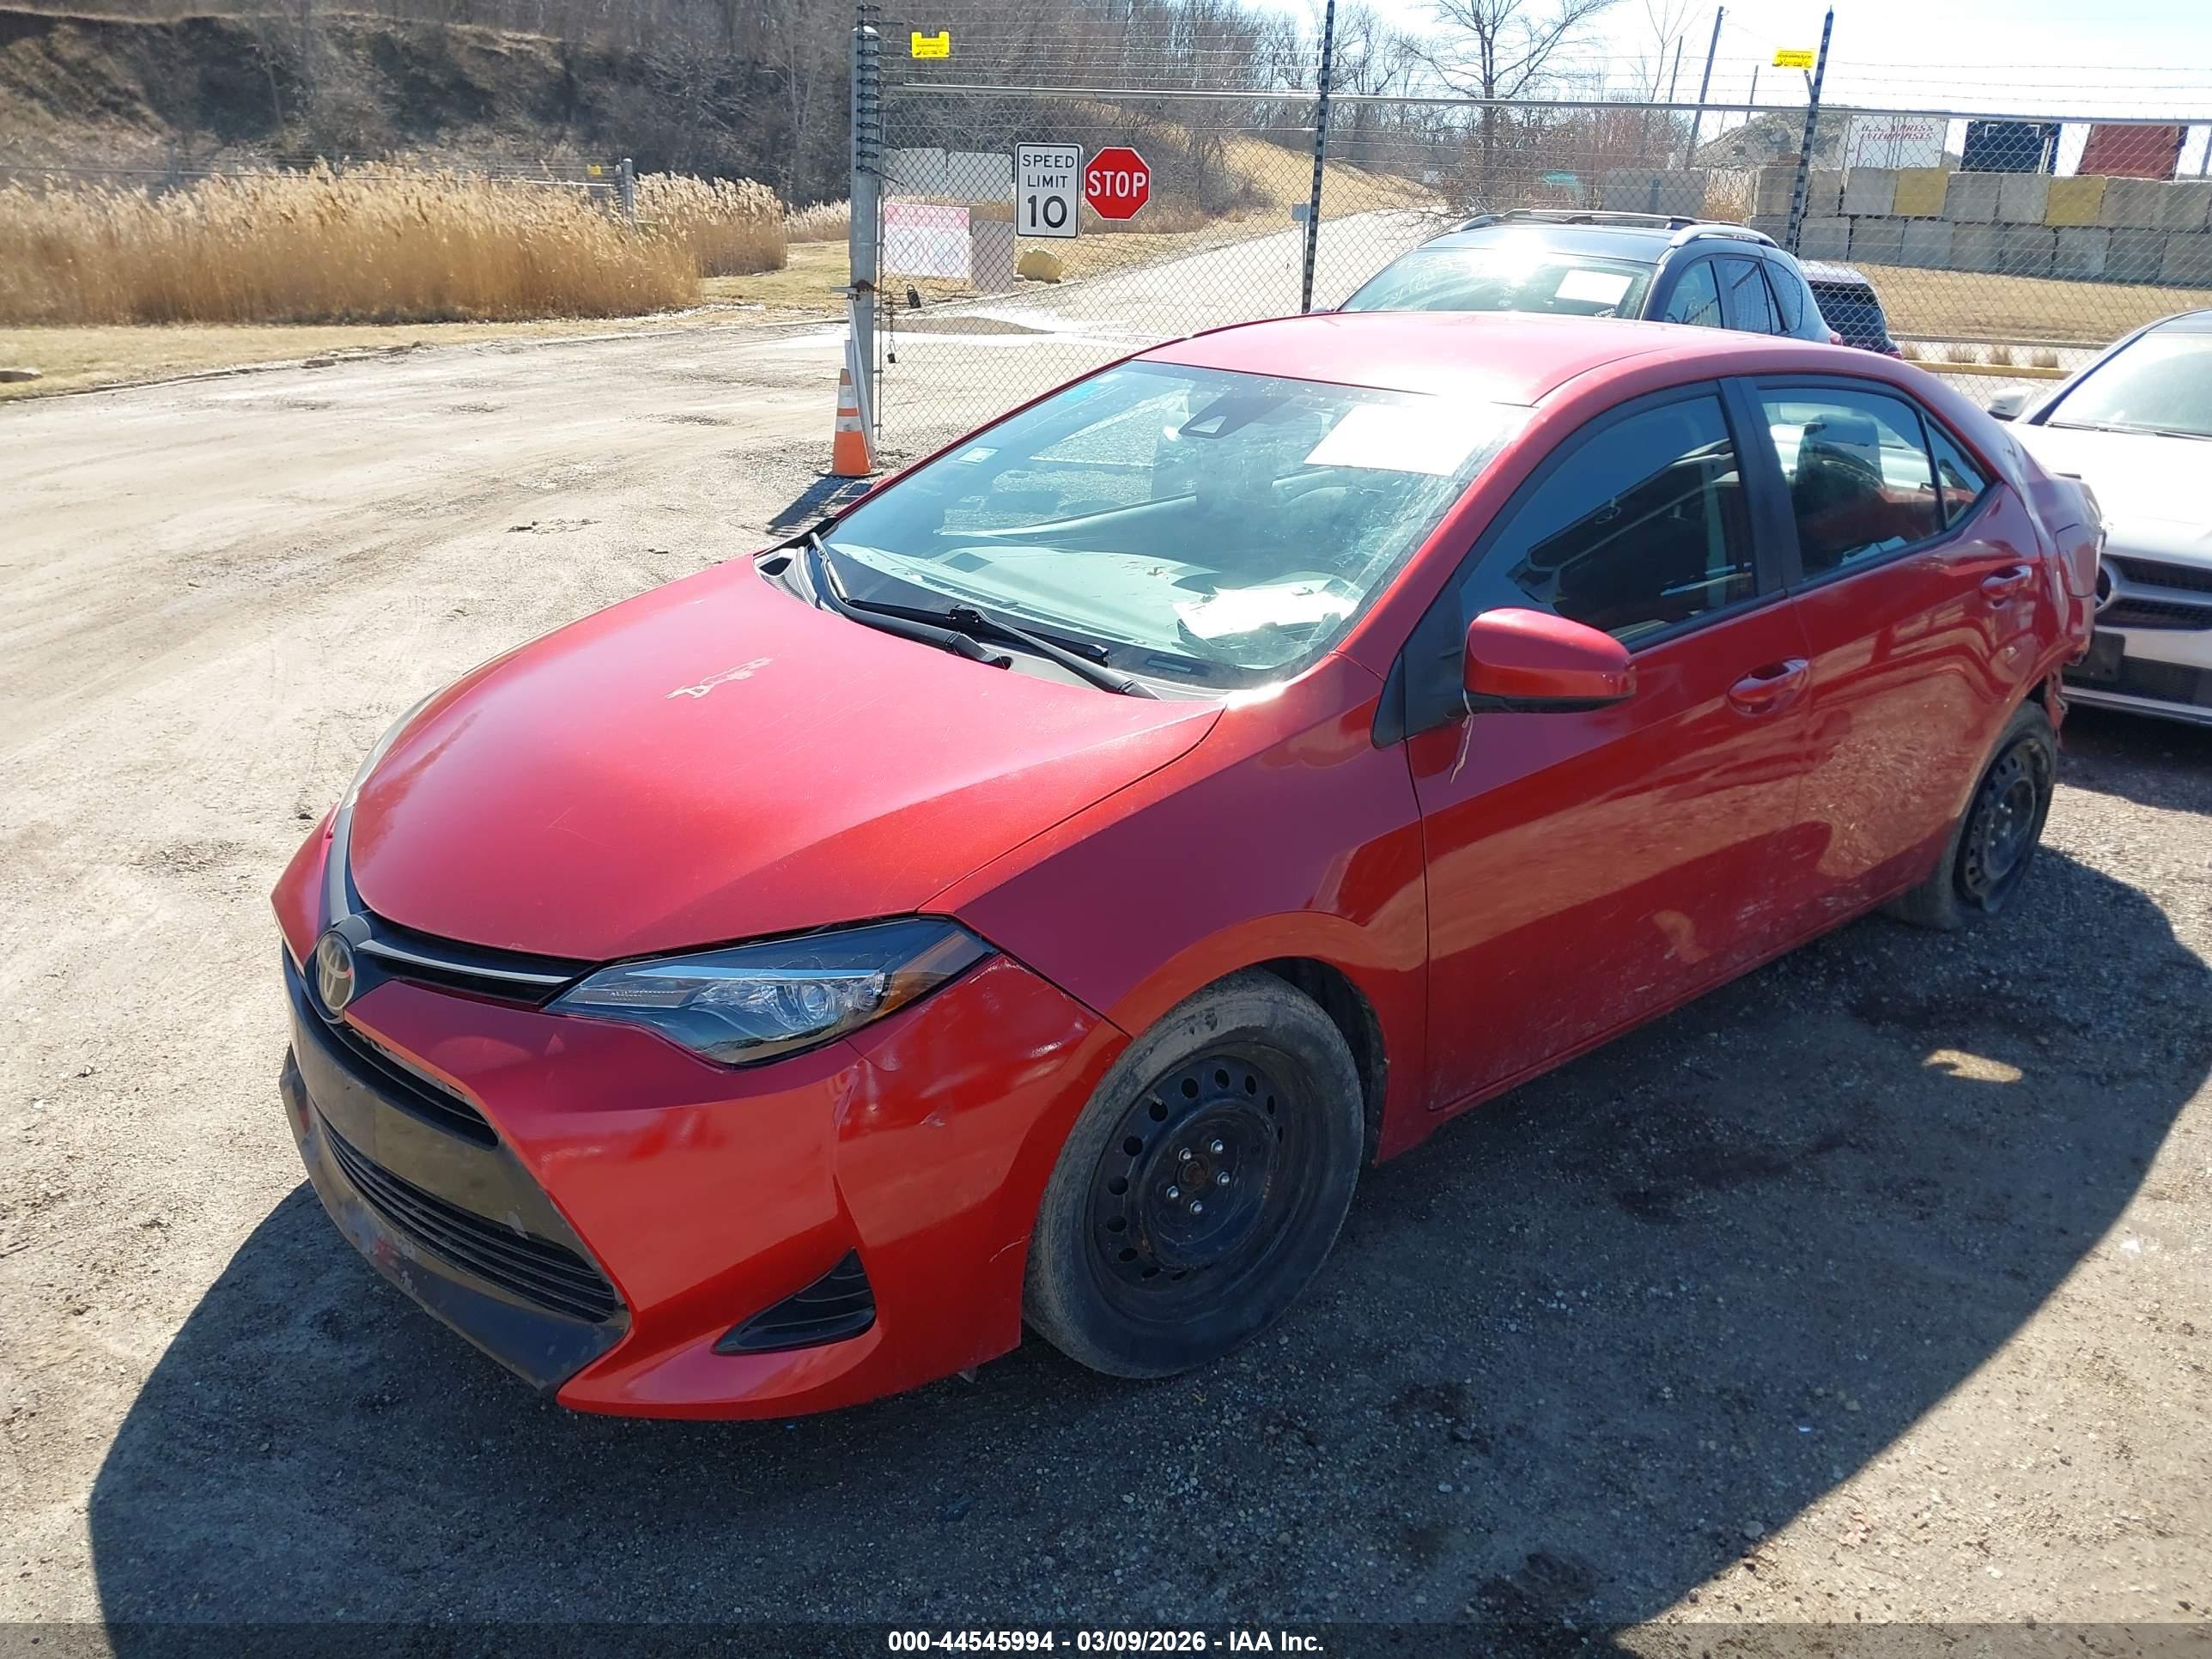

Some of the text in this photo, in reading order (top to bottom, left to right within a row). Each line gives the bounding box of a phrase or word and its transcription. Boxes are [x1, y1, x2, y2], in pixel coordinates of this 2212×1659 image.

[1022, 154, 1074, 168] SPEED
[1027, 174, 1068, 188] LIMIT
[1087, 170, 1147, 198] STOP
[1027, 195, 1067, 228] 10
